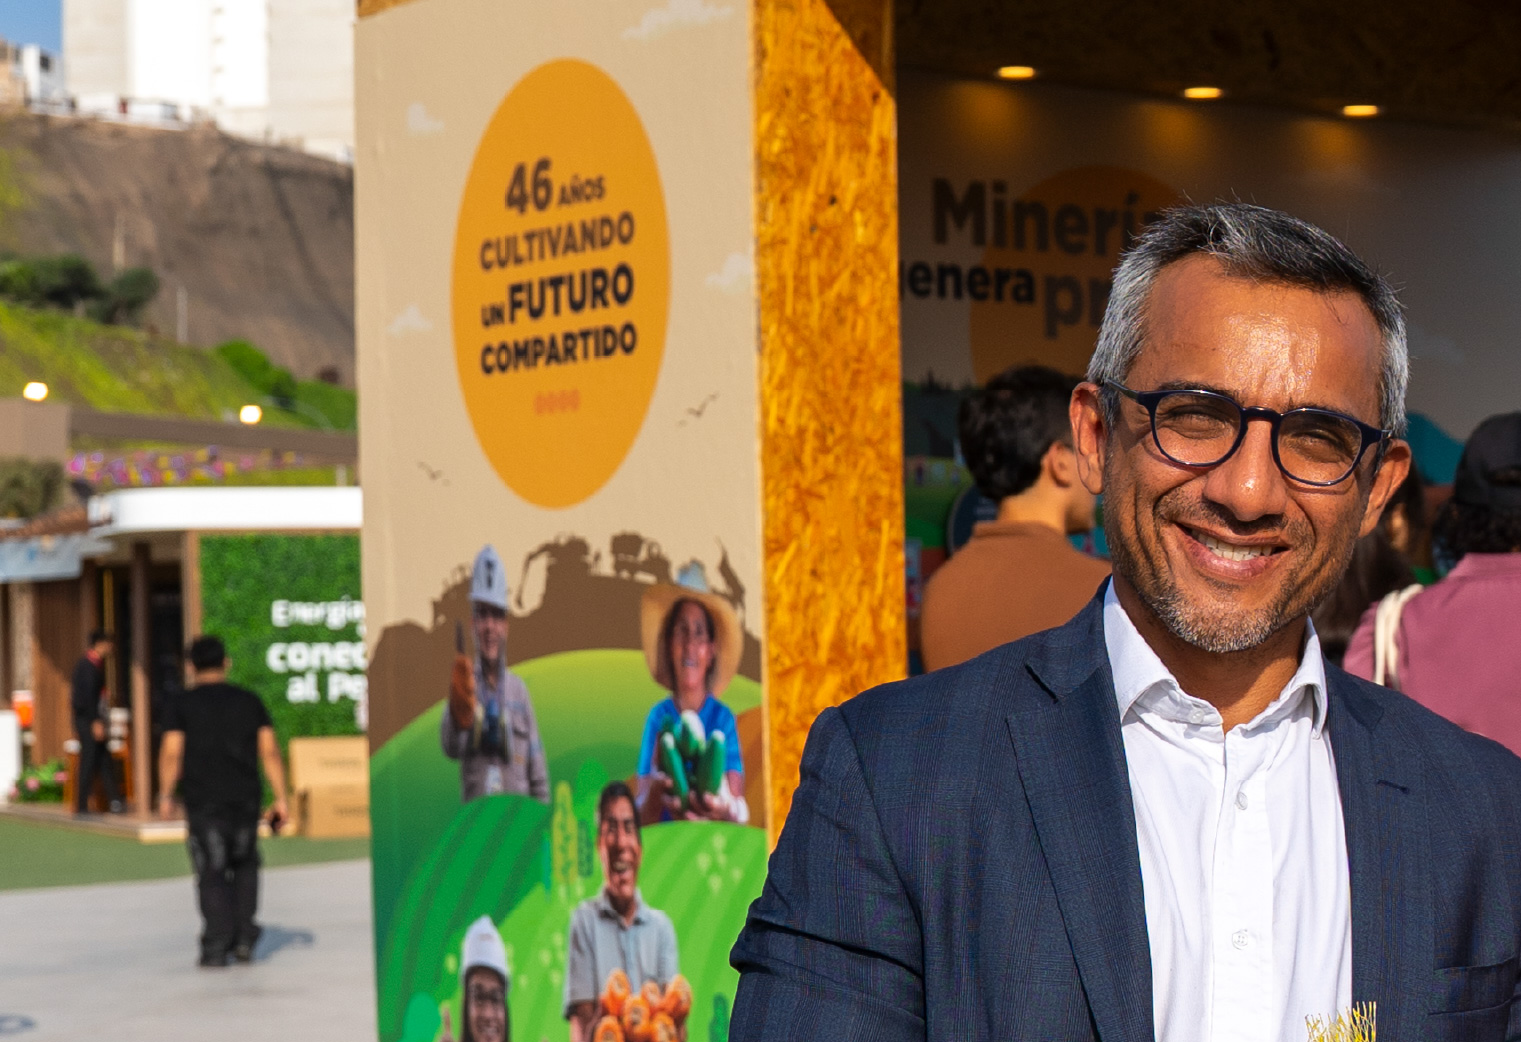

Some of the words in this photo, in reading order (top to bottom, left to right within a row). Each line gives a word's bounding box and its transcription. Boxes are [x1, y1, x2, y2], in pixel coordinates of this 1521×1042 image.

[505, 157, 552, 215] 46
[558, 174, 606, 207] AÑOS
[479, 211, 636, 271] CULTIVANDO
[932, 178, 1162, 256] Minerí
[481, 302, 505, 328] UN
[508, 262, 635, 325] FUTURO
[899, 262, 1036, 304] enera
[480, 322, 637, 375] COMPARTIDO
